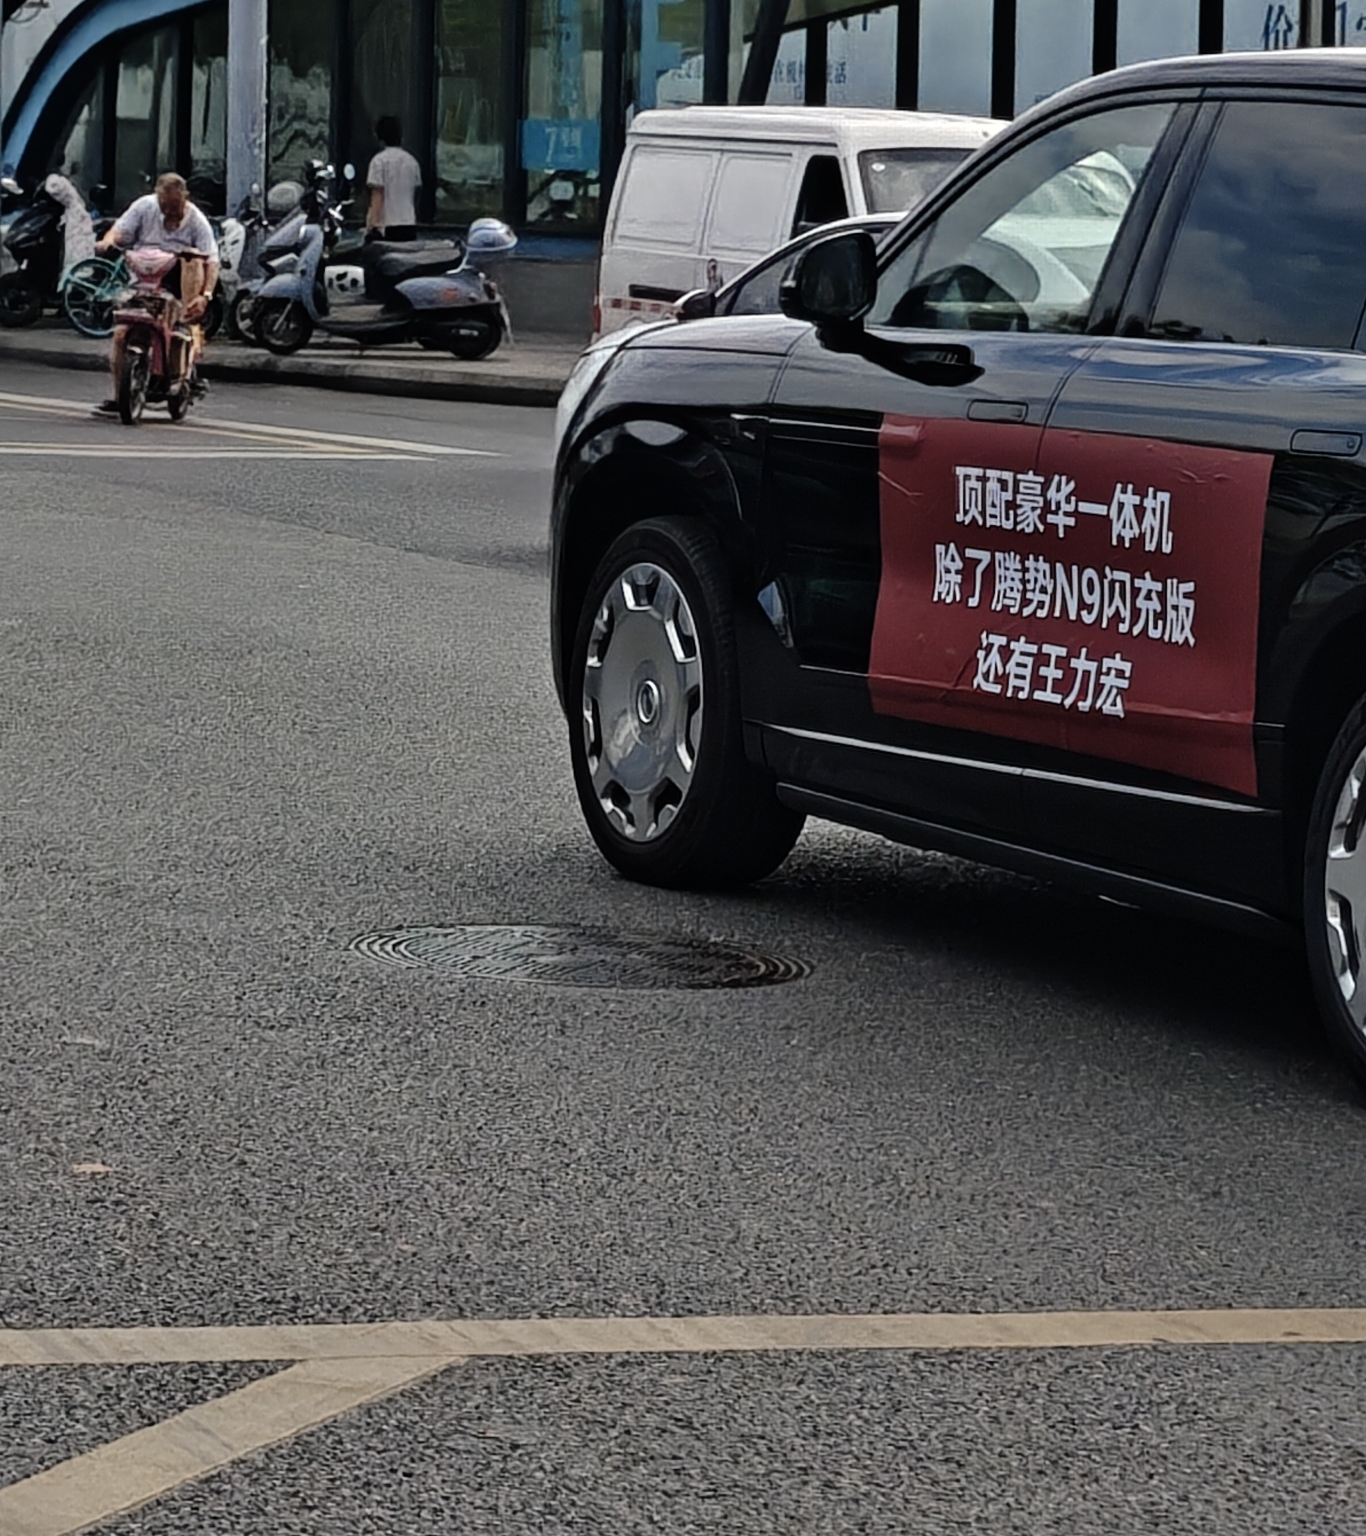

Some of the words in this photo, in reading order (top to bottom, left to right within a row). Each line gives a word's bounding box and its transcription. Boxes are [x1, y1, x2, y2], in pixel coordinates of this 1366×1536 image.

[954, 465, 1174, 554] 顶配豪华一体机
[932, 541, 1197, 648] 除了腾势N9闪充版
[972, 630, 1133, 719] 还有王力宏
